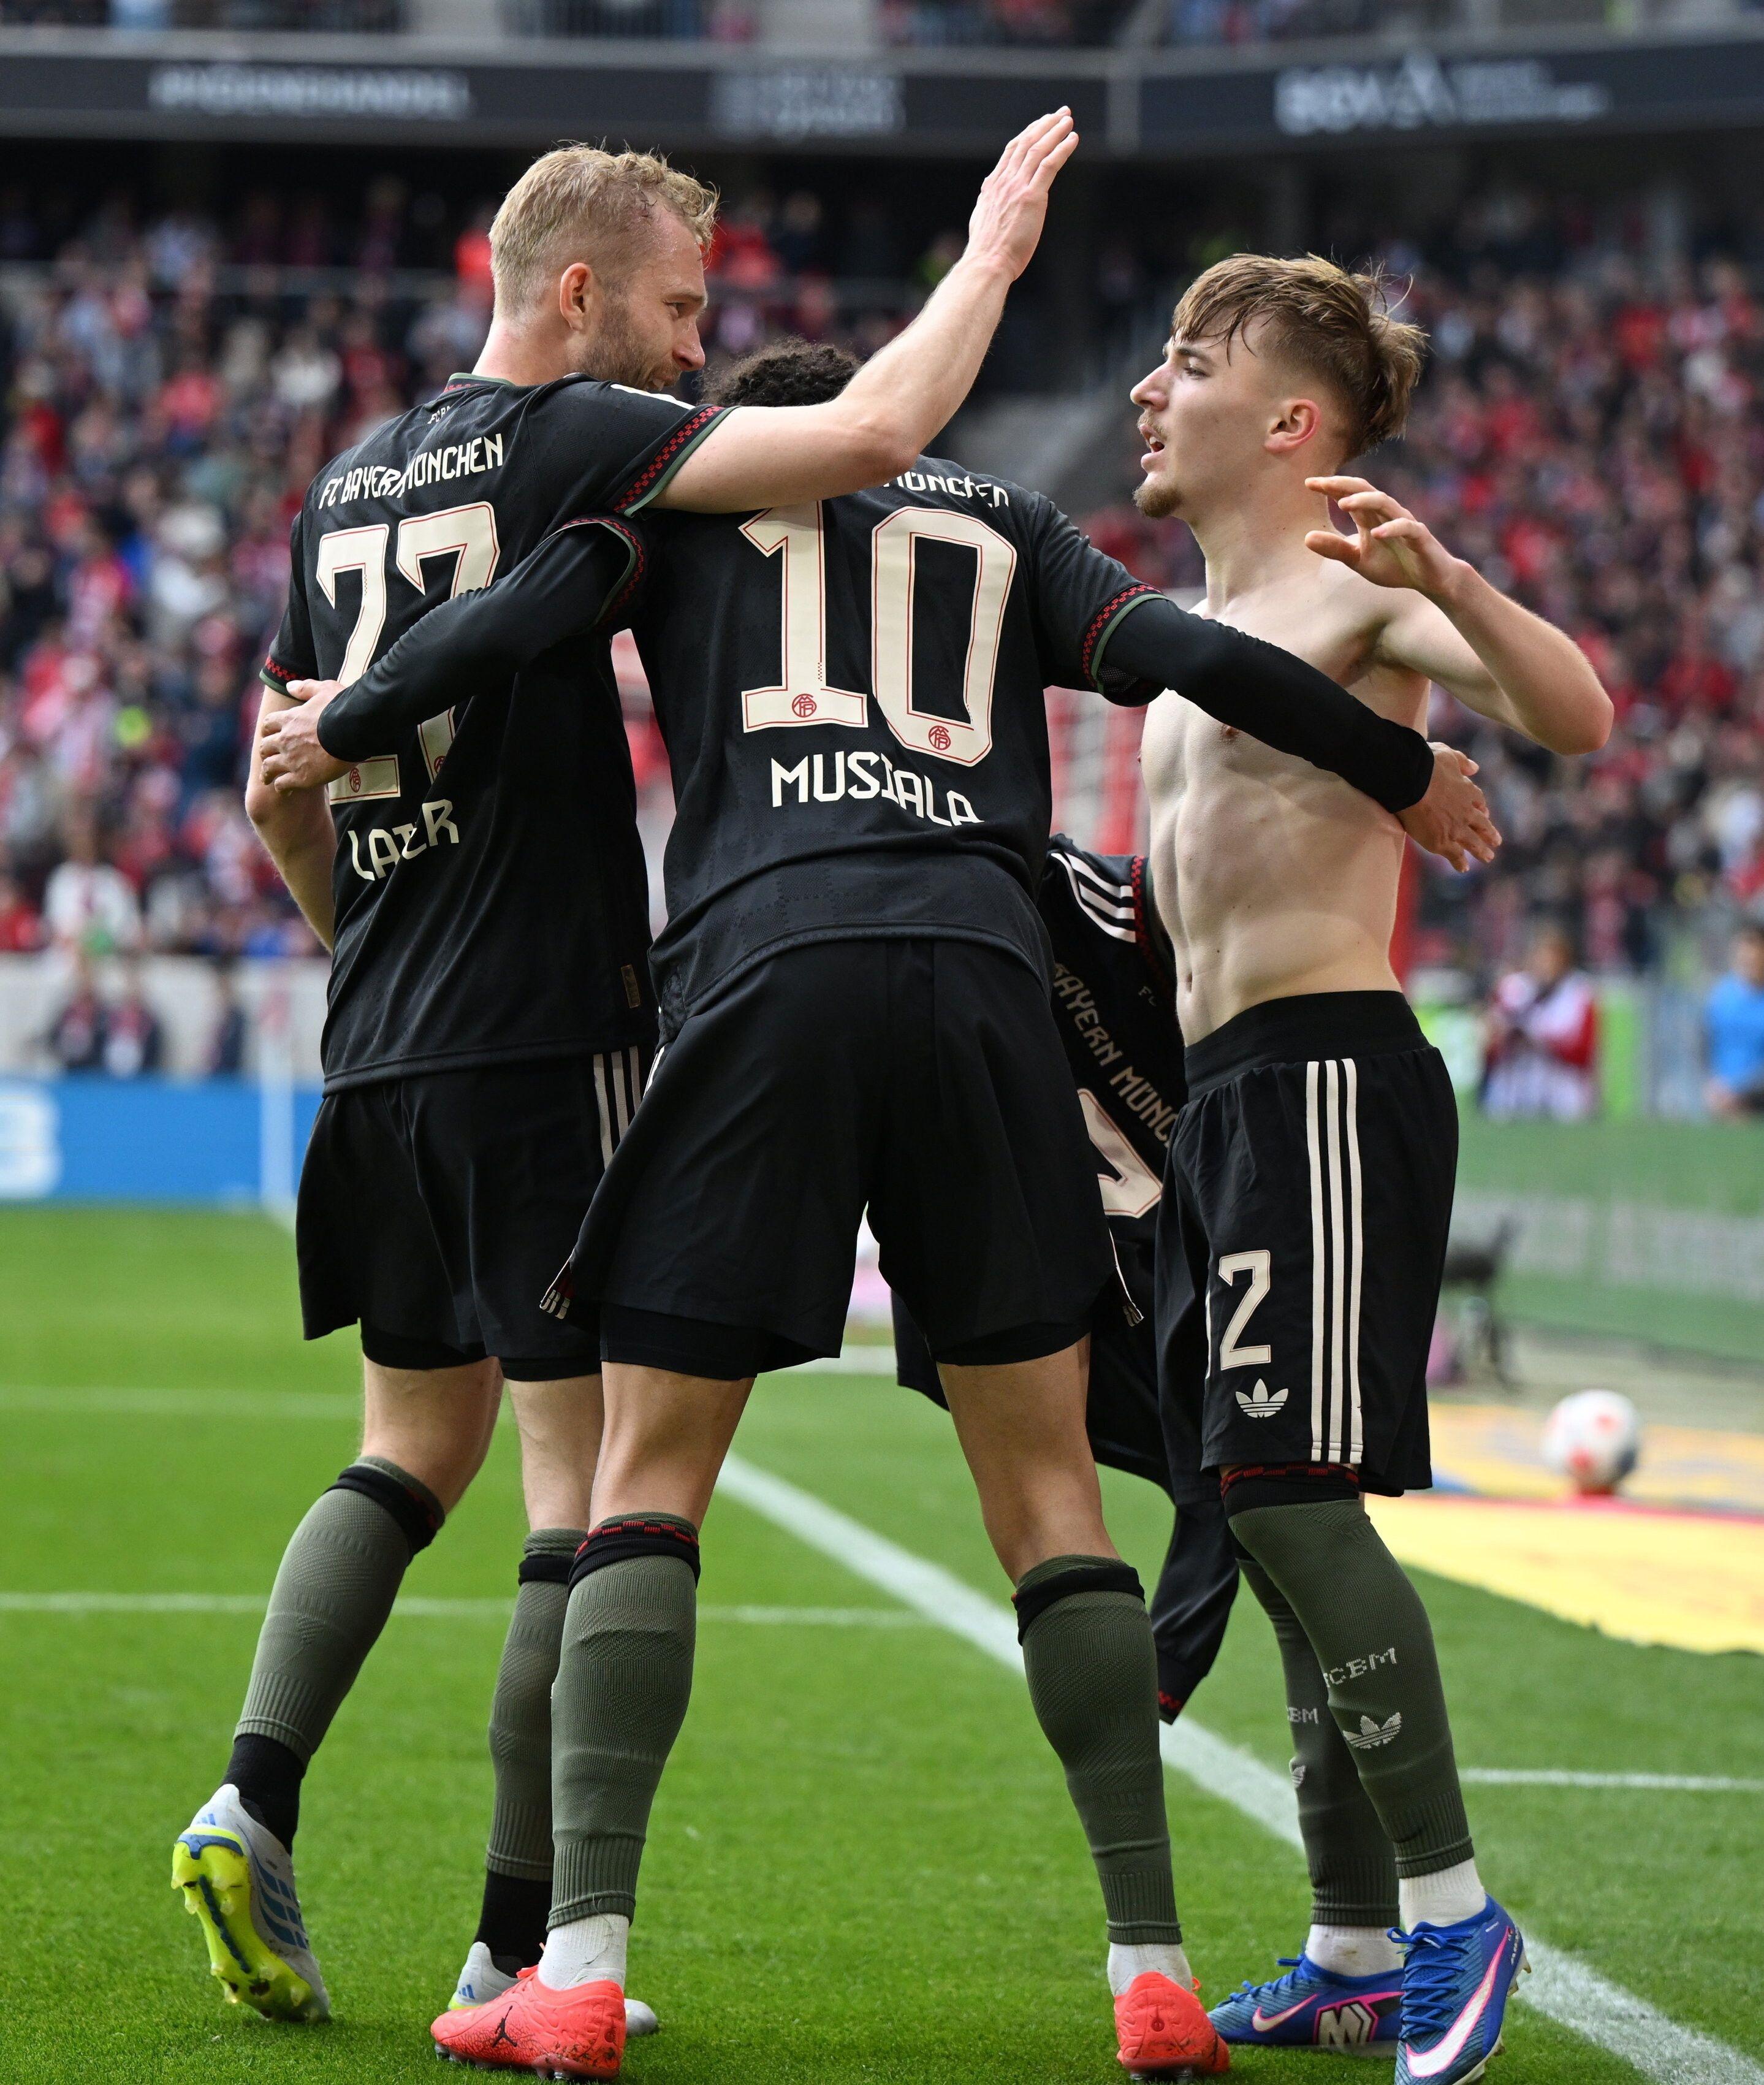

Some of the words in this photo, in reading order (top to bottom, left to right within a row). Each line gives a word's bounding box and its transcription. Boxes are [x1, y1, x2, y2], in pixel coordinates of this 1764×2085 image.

[319, 478, 343, 509] FC
[738, 500, 1017, 768] 10
[771, 750, 986, 826] MUSIALA
